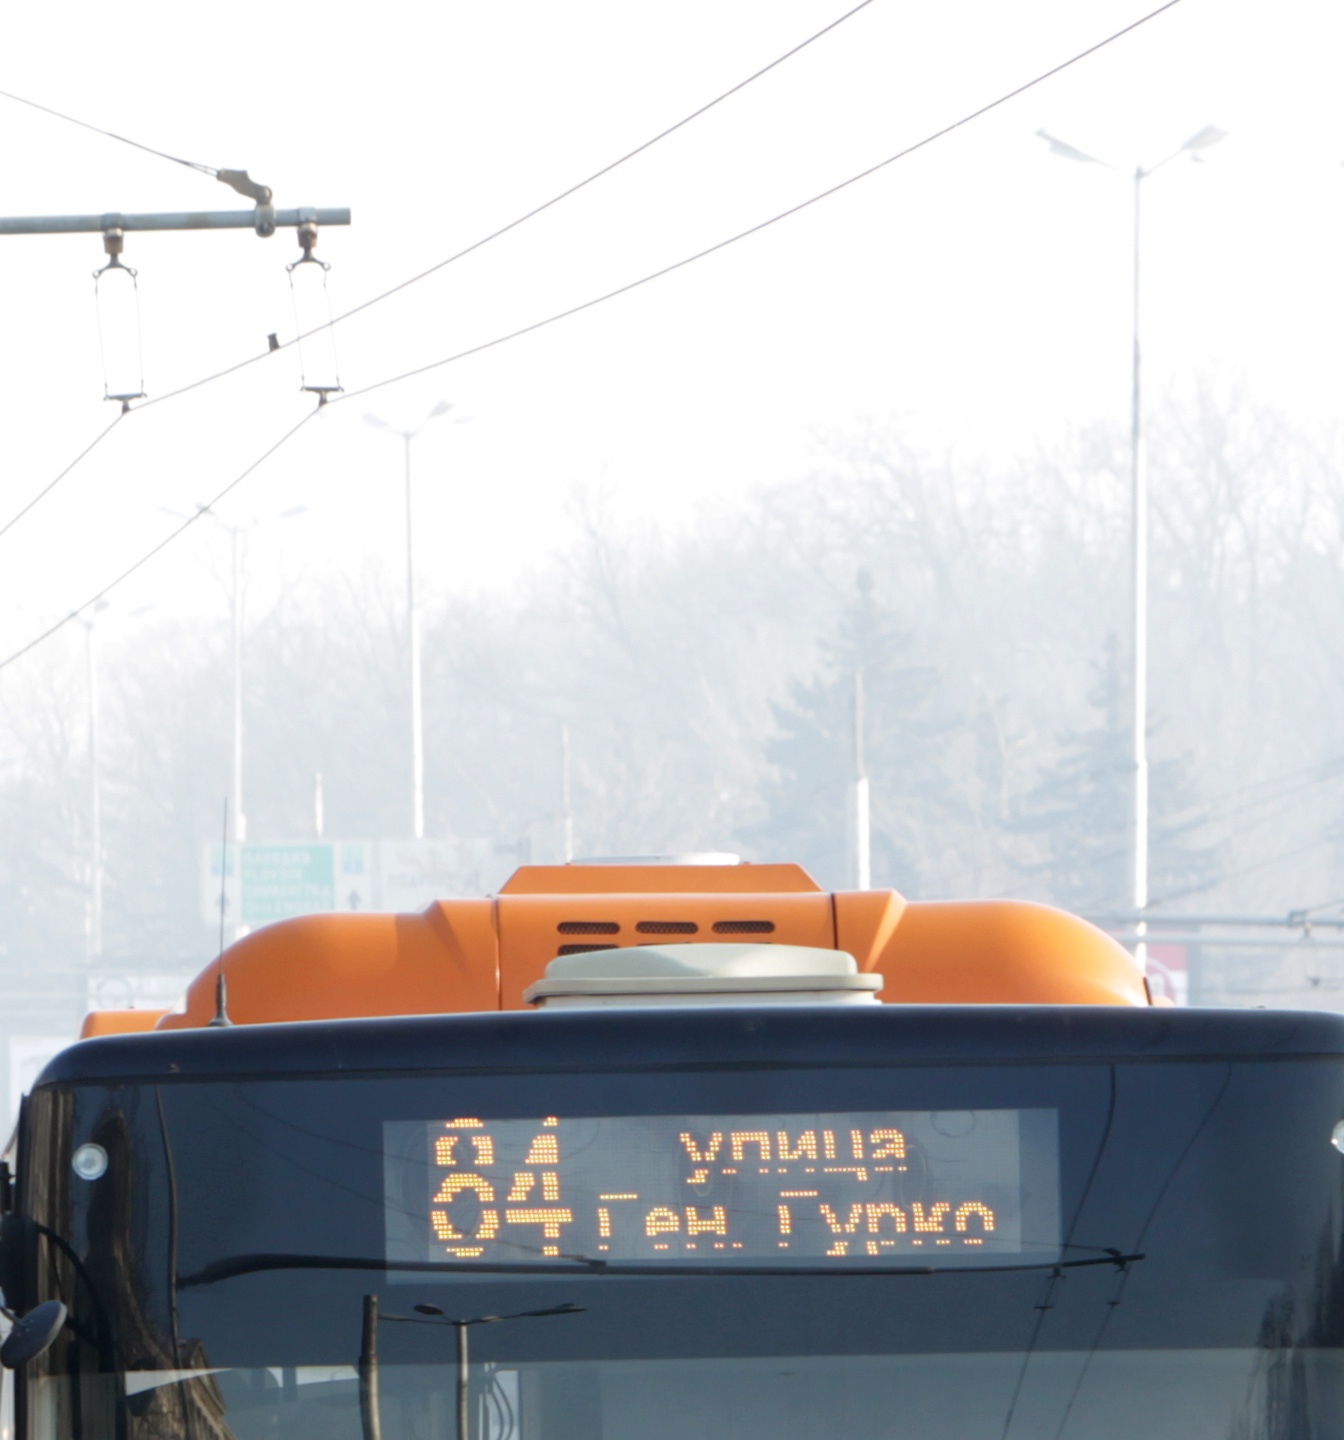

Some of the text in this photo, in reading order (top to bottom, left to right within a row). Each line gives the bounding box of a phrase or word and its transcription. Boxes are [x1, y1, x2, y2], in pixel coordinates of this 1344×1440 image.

[432, 1116, 572, 1257] 84
[679, 1128, 907, 1184] улица
[597, 1190, 995, 1256] Ген Гурко
